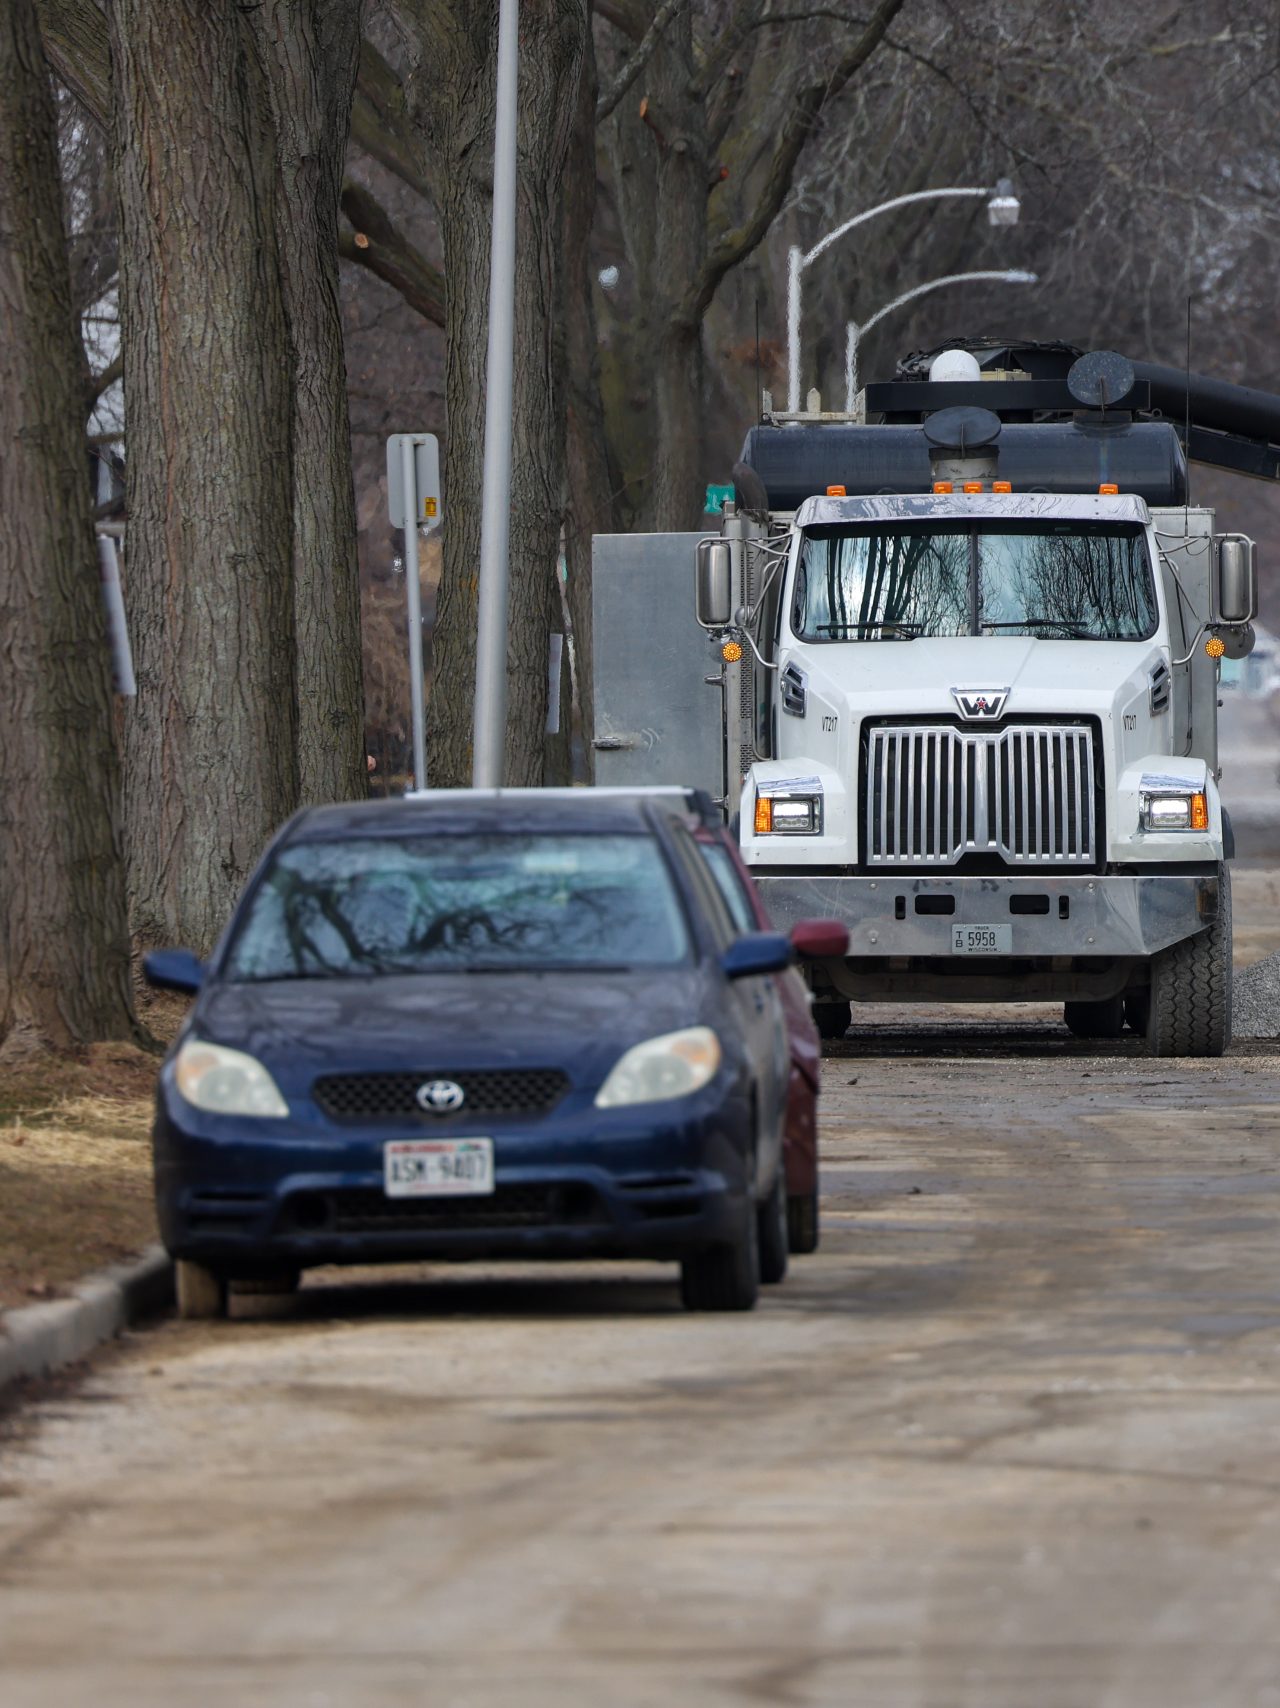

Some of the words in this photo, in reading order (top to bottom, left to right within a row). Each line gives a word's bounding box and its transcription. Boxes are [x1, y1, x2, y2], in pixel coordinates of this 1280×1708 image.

[821, 716, 838, 731] VT217
[1122, 714, 1137, 731] VT217
[968, 931, 996, 947] 5958
